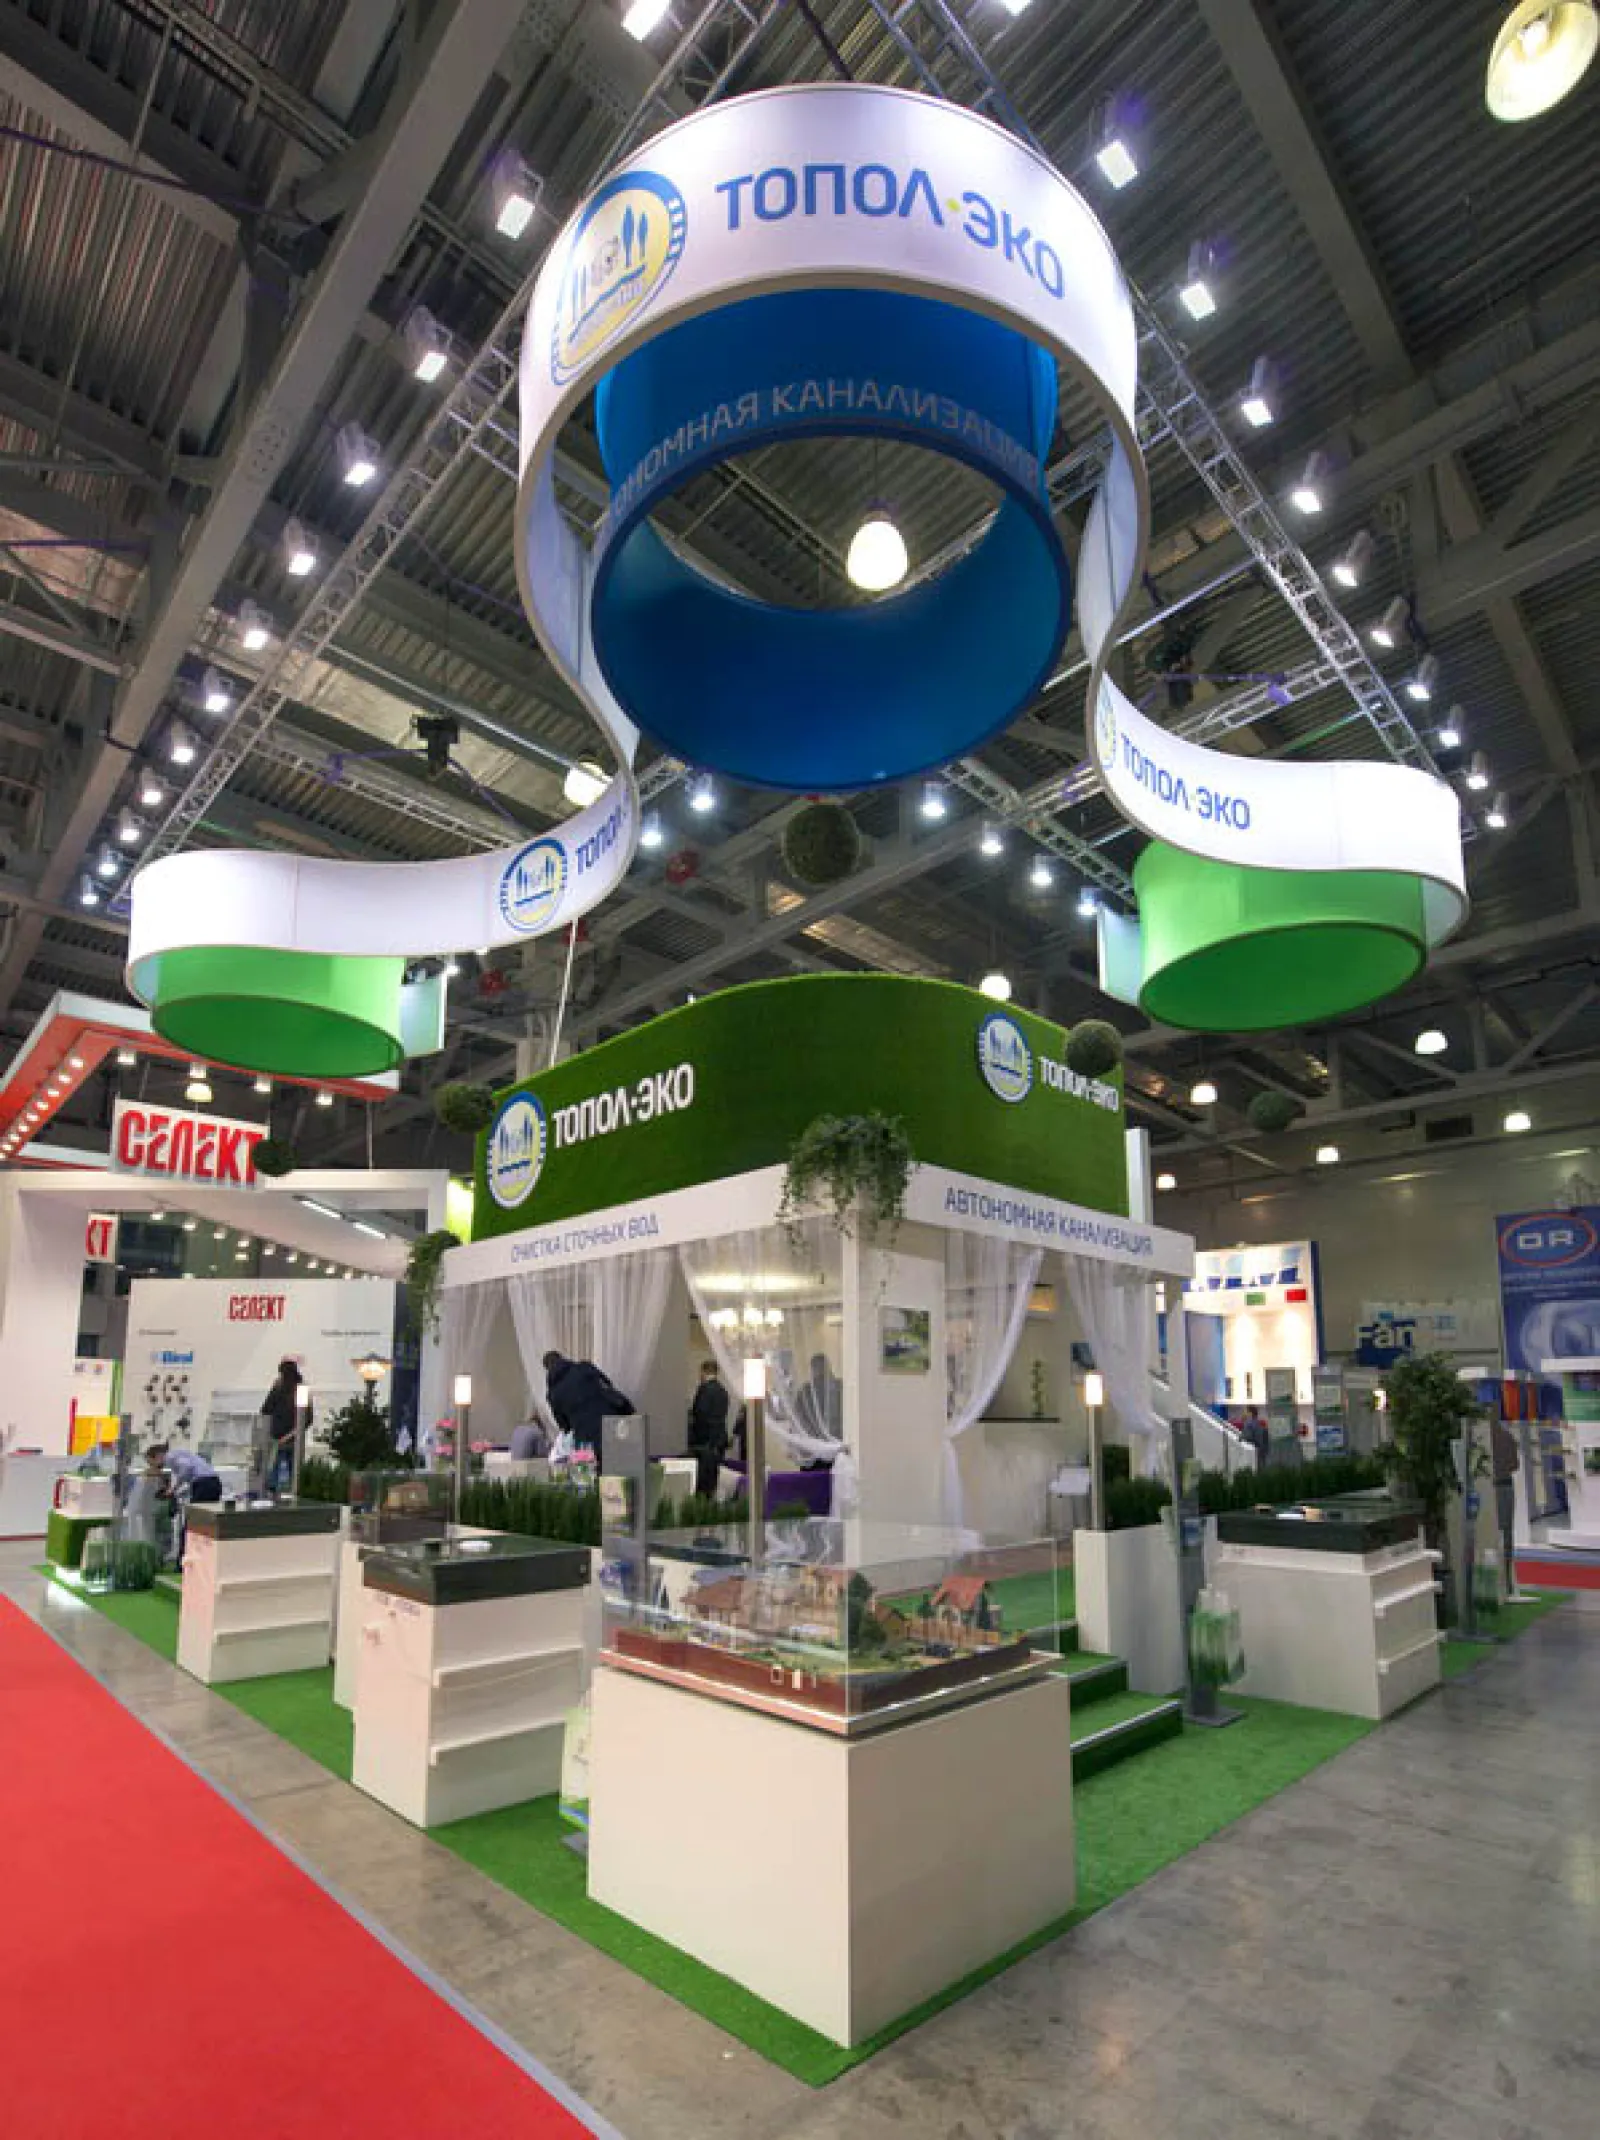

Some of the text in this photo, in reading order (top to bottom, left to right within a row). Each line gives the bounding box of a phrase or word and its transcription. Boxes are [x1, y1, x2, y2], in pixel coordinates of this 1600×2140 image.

[118, 1109, 264, 1184] СЕЛЕКТ
[563, 1222, 627, 1253] СТОЧНЫХ
[627, 1214, 659, 1240] ВОД
[944, 1187, 1153, 1255] АВТОНОМНАЯ КАНАЛИЗАЦИЯ
[229, 1294, 286, 1322] СЕЛЕКТ
